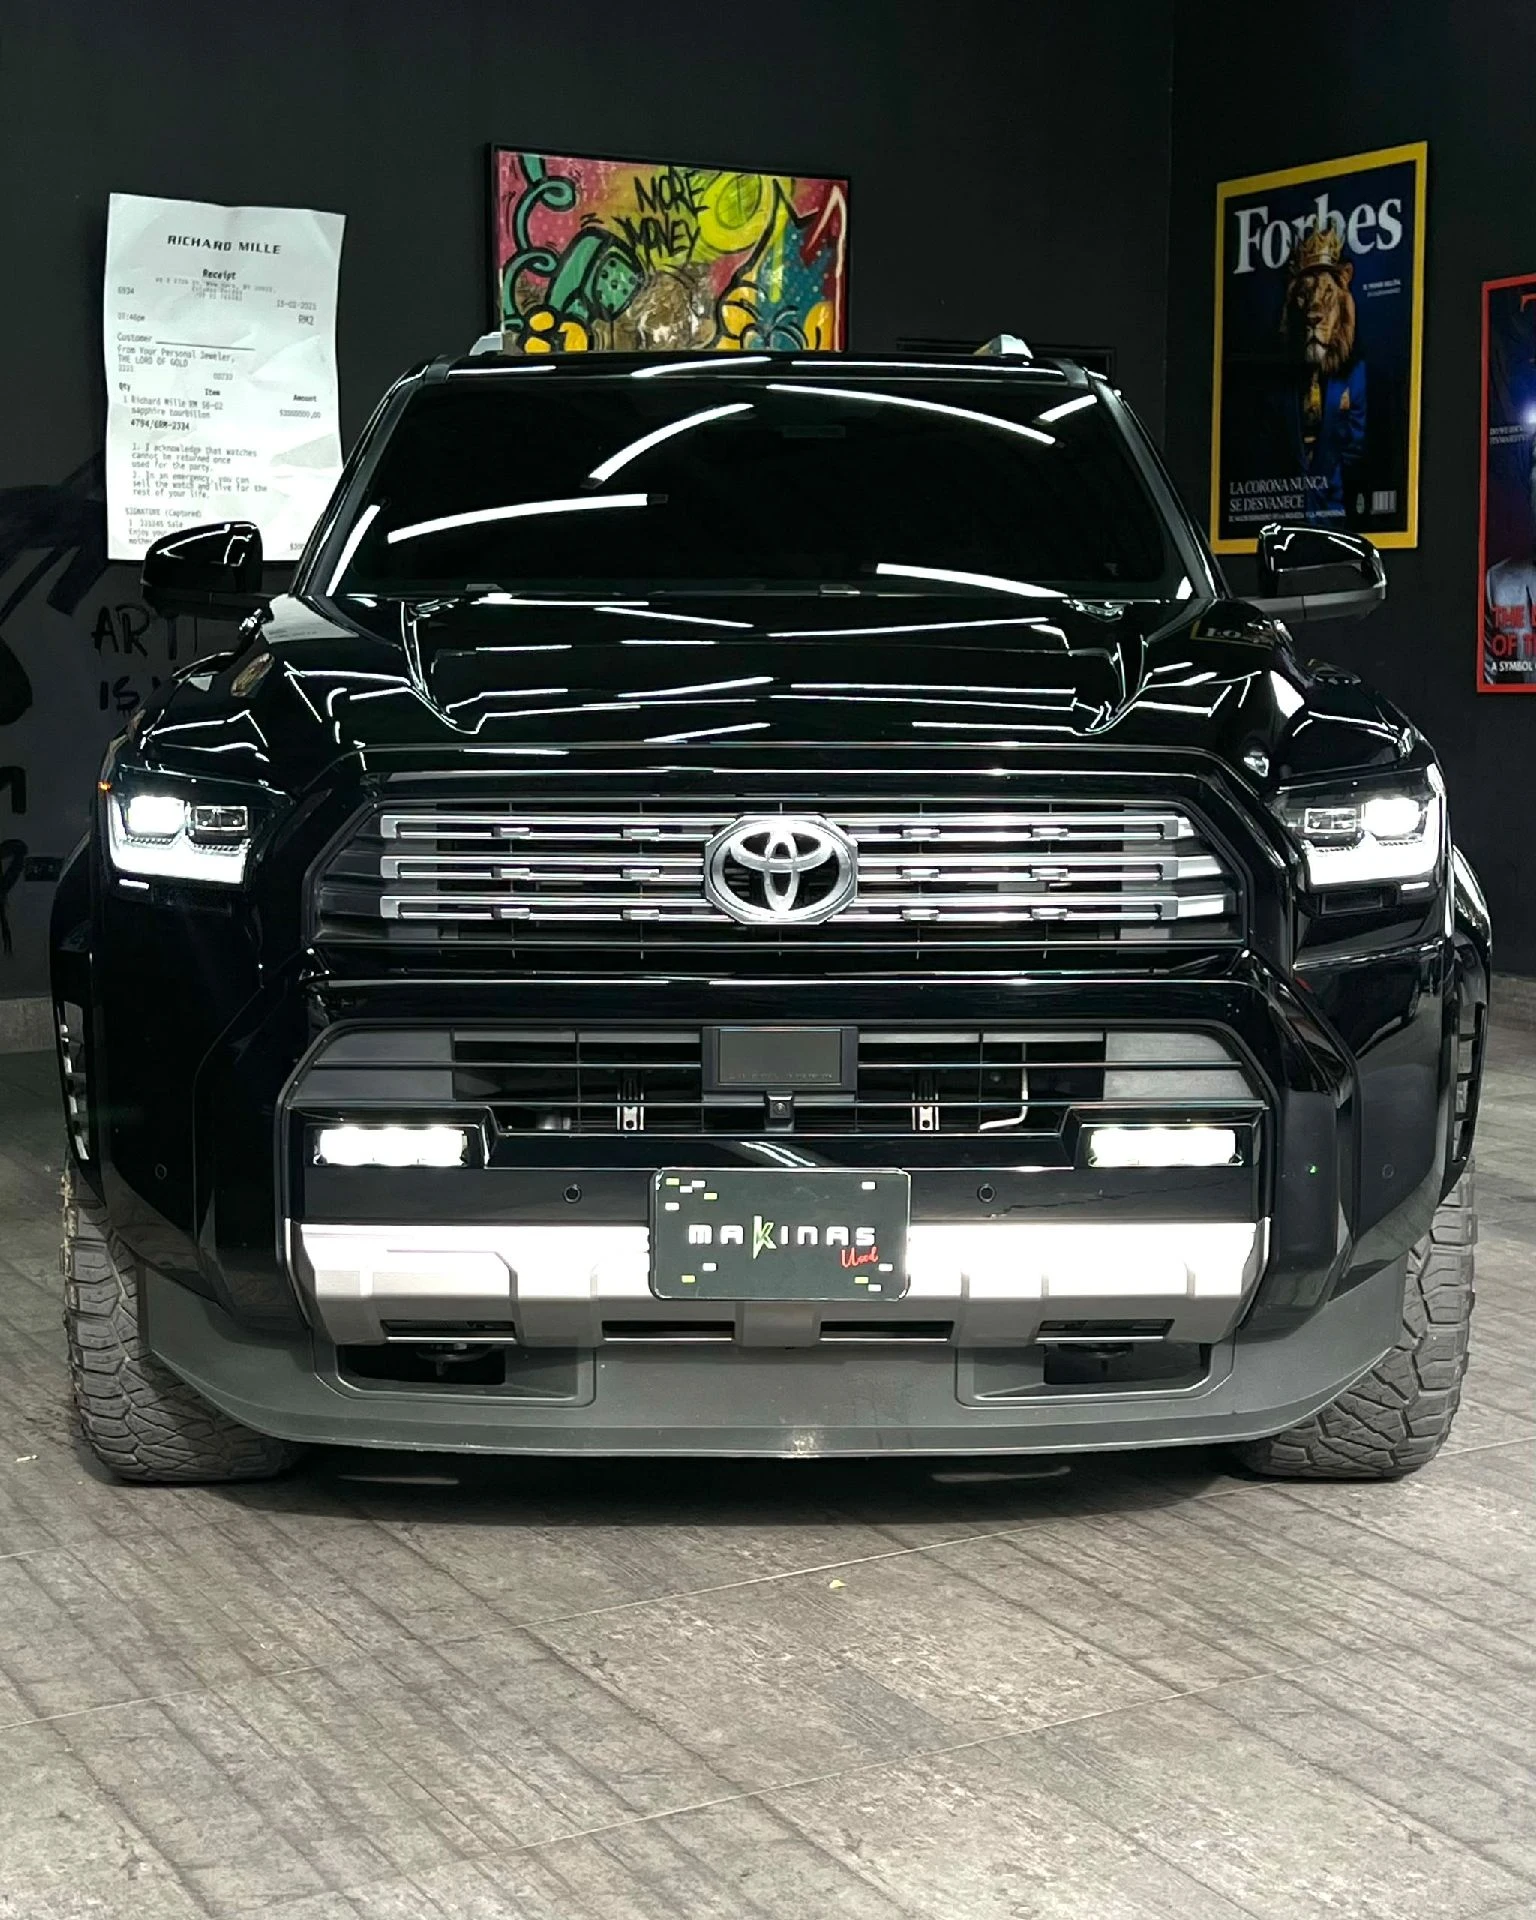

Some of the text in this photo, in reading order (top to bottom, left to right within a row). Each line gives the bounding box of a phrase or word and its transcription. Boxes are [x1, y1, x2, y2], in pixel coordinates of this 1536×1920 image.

[1233, 193, 1402, 274] Forbes
[167, 235, 281, 254] RICHARD MILLE
[202, 268, 236, 281] Receipt
[117, 332, 152, 342] Customer
[117, 344, 136, 354] From
[140, 347, 157, 355] Your
[161, 348, 196, 359] Personal
[118, 354, 189, 368] THE LORD OF GOLD
[131, 395, 161, 405] Richard
[164, 398, 186, 408] Mille
[205, 388, 220, 396] Item
[293, 394, 317, 402] Amount
[131, 407, 210, 419] sapphire tourbillon
[131, 452, 159, 460] cannot
[163, 453, 172, 461] be
[176, 454, 210, 463] returned
[154, 444, 201, 456] acknowledge
[205, 446, 222, 456] that
[226, 448, 258, 458] watches
[155, 458, 167, 469] for
[173, 461, 185, 470] the
[133, 479, 267, 492] sell the watch and live for the
[1230, 475, 1329, 495] LA CORONA NUNCA
[133, 488, 150, 496] rest
[155, 488, 164, 496] of
[168, 490, 185, 499] your
[1230, 494, 1305, 513] SE DESVANECE
[125, 507, 161, 516] SIGNATURE
[129, 528, 150, 538] Enjoy
[1491, 605, 1524, 629] THE
[1491, 633, 1517, 657] OF
[1499, 660, 1533, 672] SYMBOL
